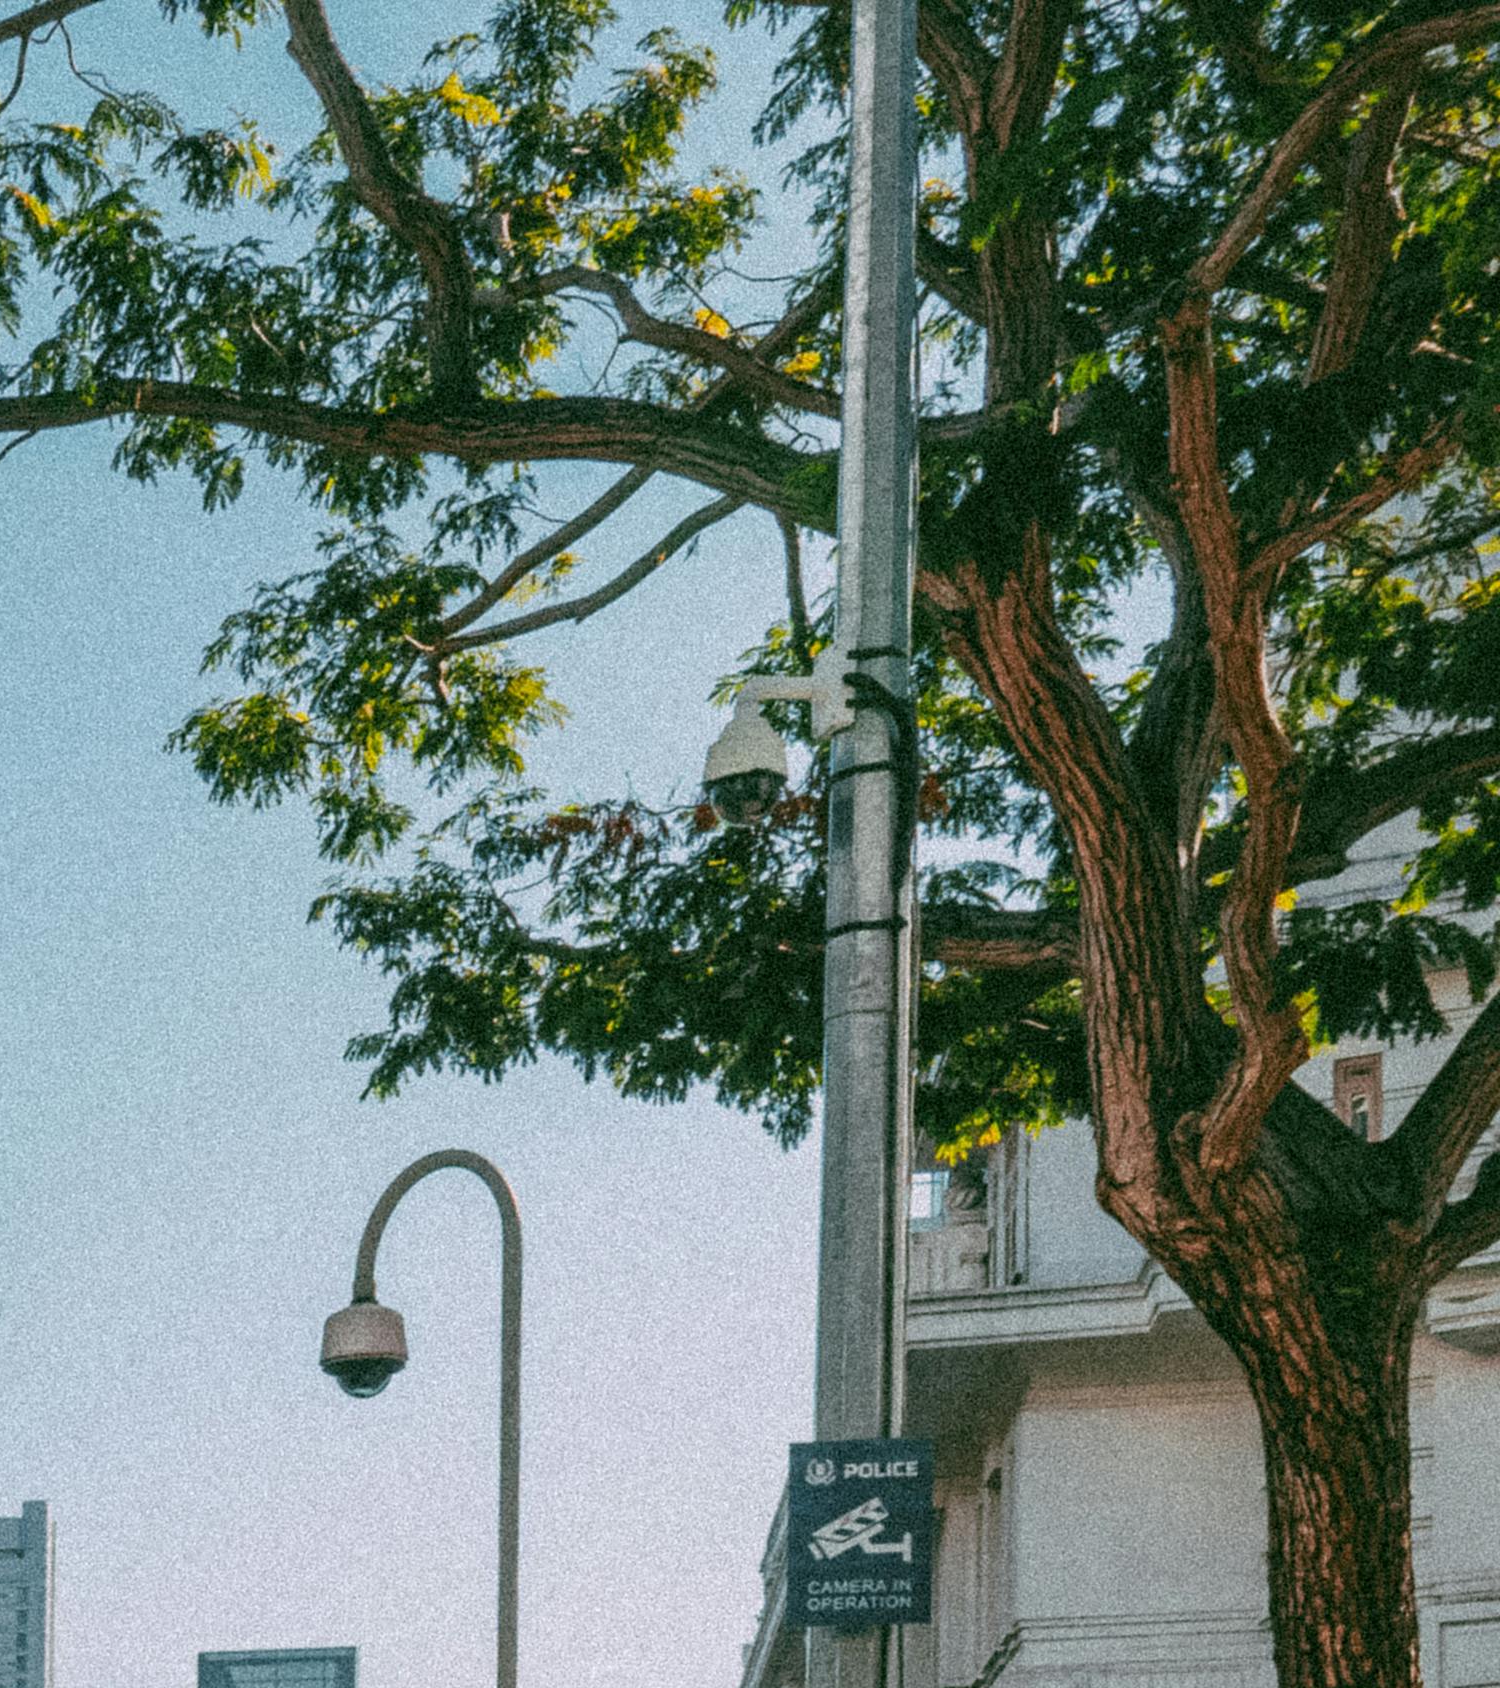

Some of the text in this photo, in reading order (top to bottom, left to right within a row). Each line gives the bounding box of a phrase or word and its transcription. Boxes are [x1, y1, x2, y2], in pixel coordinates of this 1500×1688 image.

[843, 1460, 919, 1479] POLICE
[808, 1578, 912, 1595] CAMERA IN
[806, 1595, 912, 1611] OPERATION
